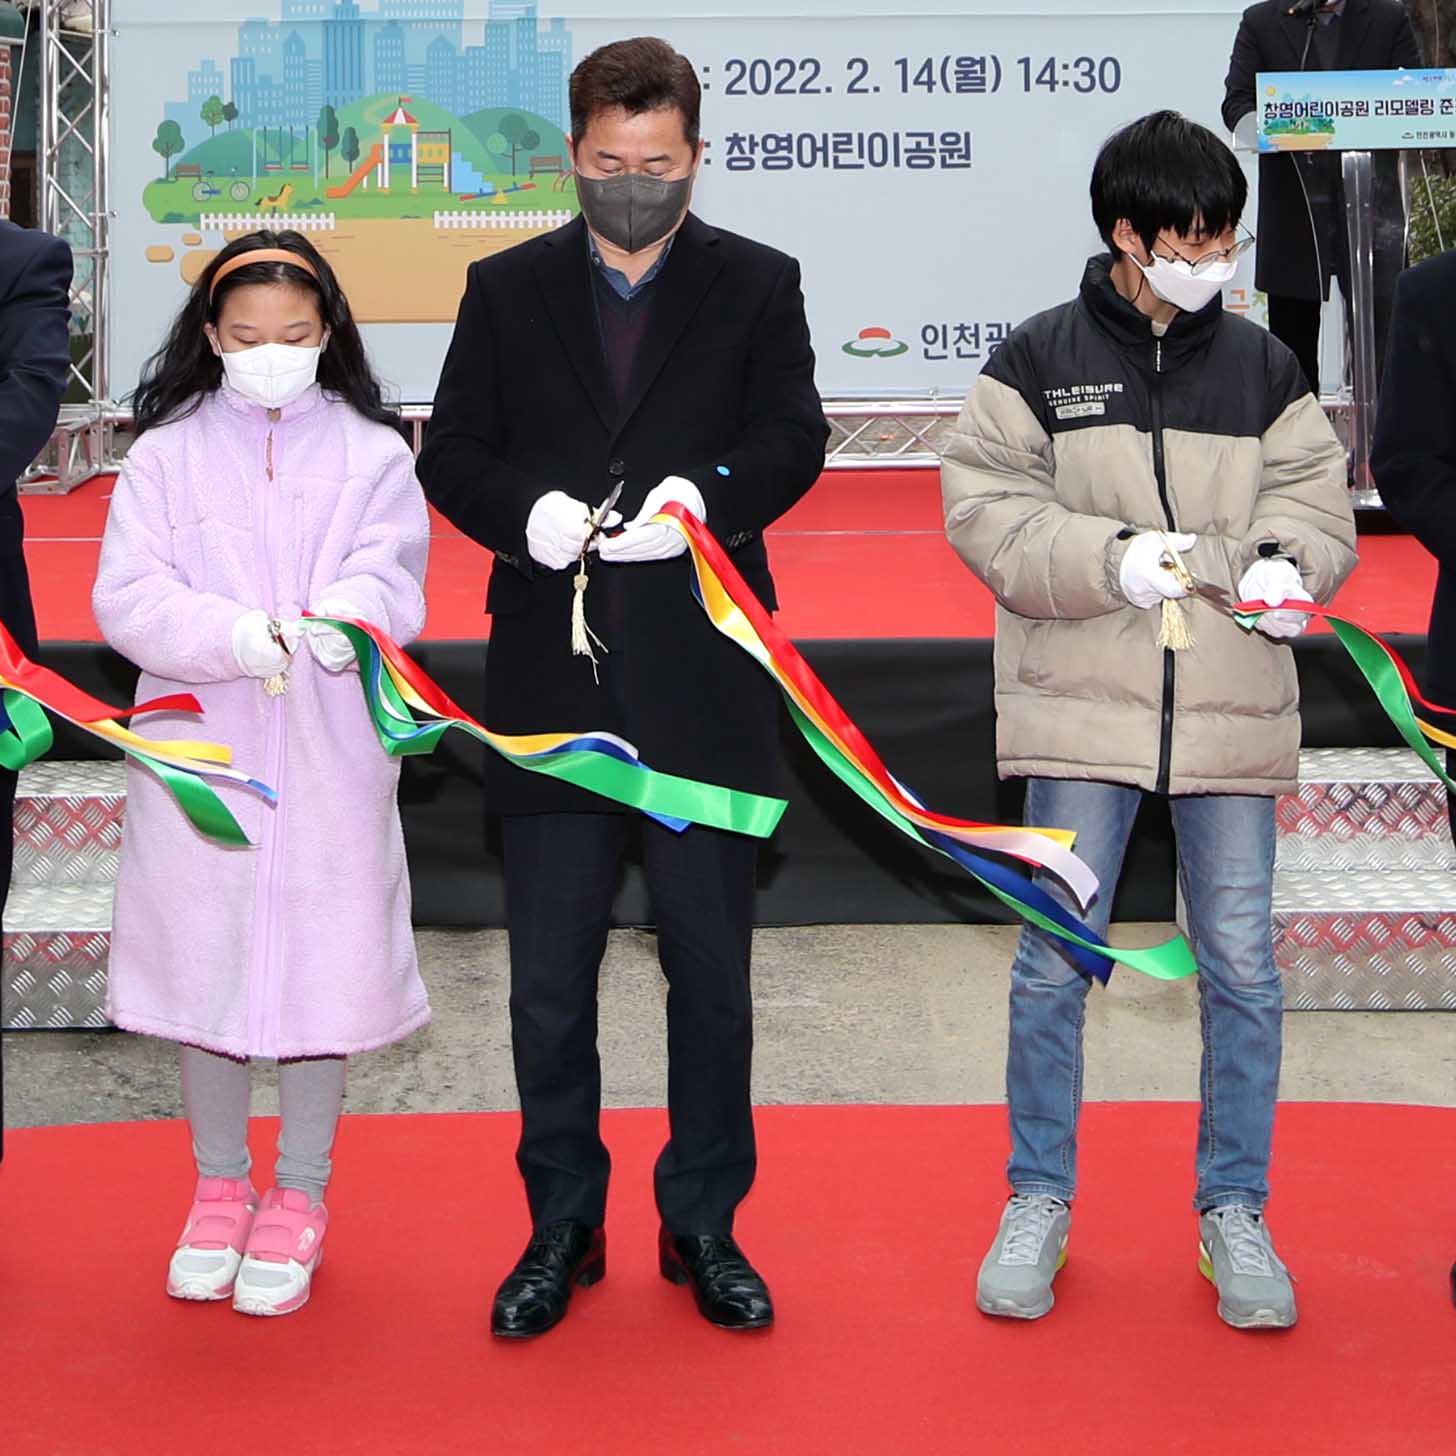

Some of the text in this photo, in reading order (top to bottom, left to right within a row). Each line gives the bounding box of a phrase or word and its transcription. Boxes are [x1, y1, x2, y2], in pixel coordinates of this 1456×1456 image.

[724, 57, 833, 95] 2022.
[846, 57, 880, 94] 2.
[894, 55, 1002, 94] 14(월)
[1016, 56, 1122, 94] 14:30
[1264, 99, 1370, 120] 창영어린이공원
[1375, 98, 1434, 117] 리모델링
[724, 130, 972, 172] 창영어린이공원
